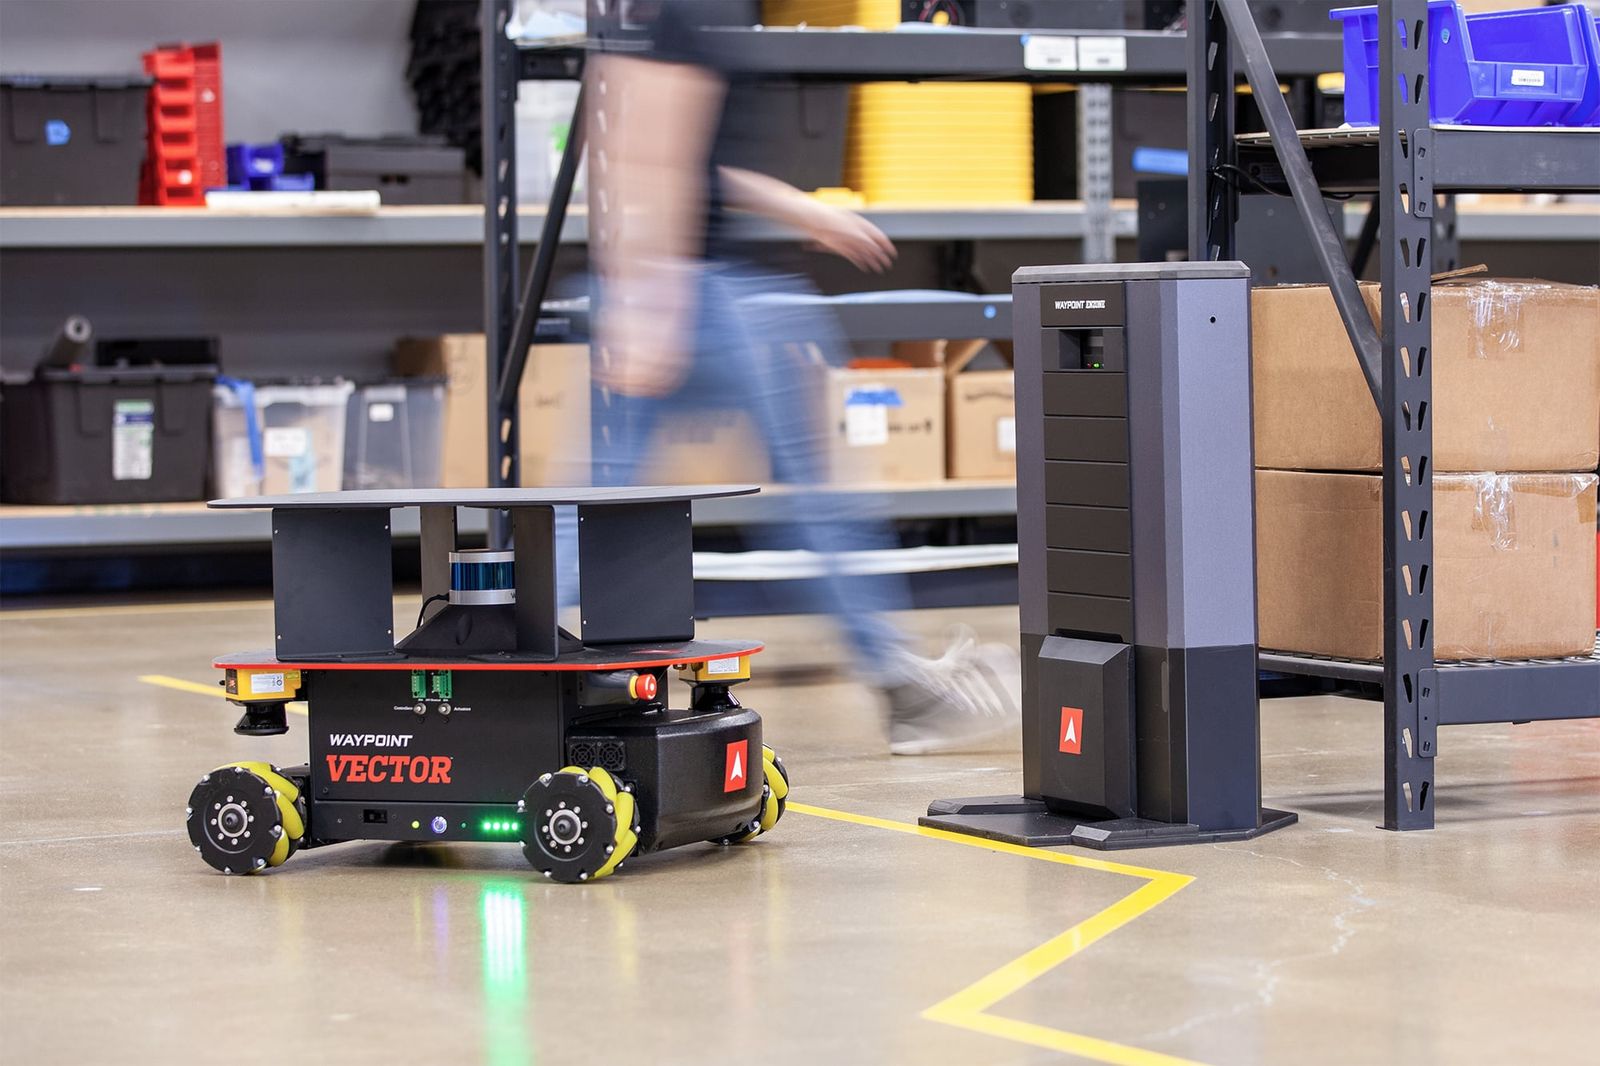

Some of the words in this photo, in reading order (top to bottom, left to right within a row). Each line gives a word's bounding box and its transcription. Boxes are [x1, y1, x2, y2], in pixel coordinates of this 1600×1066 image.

[1054, 300, 1086, 310] WAYPOINT
[329, 734, 413, 747] WAYPOINT
[326, 754, 452, 784] VECTOR
